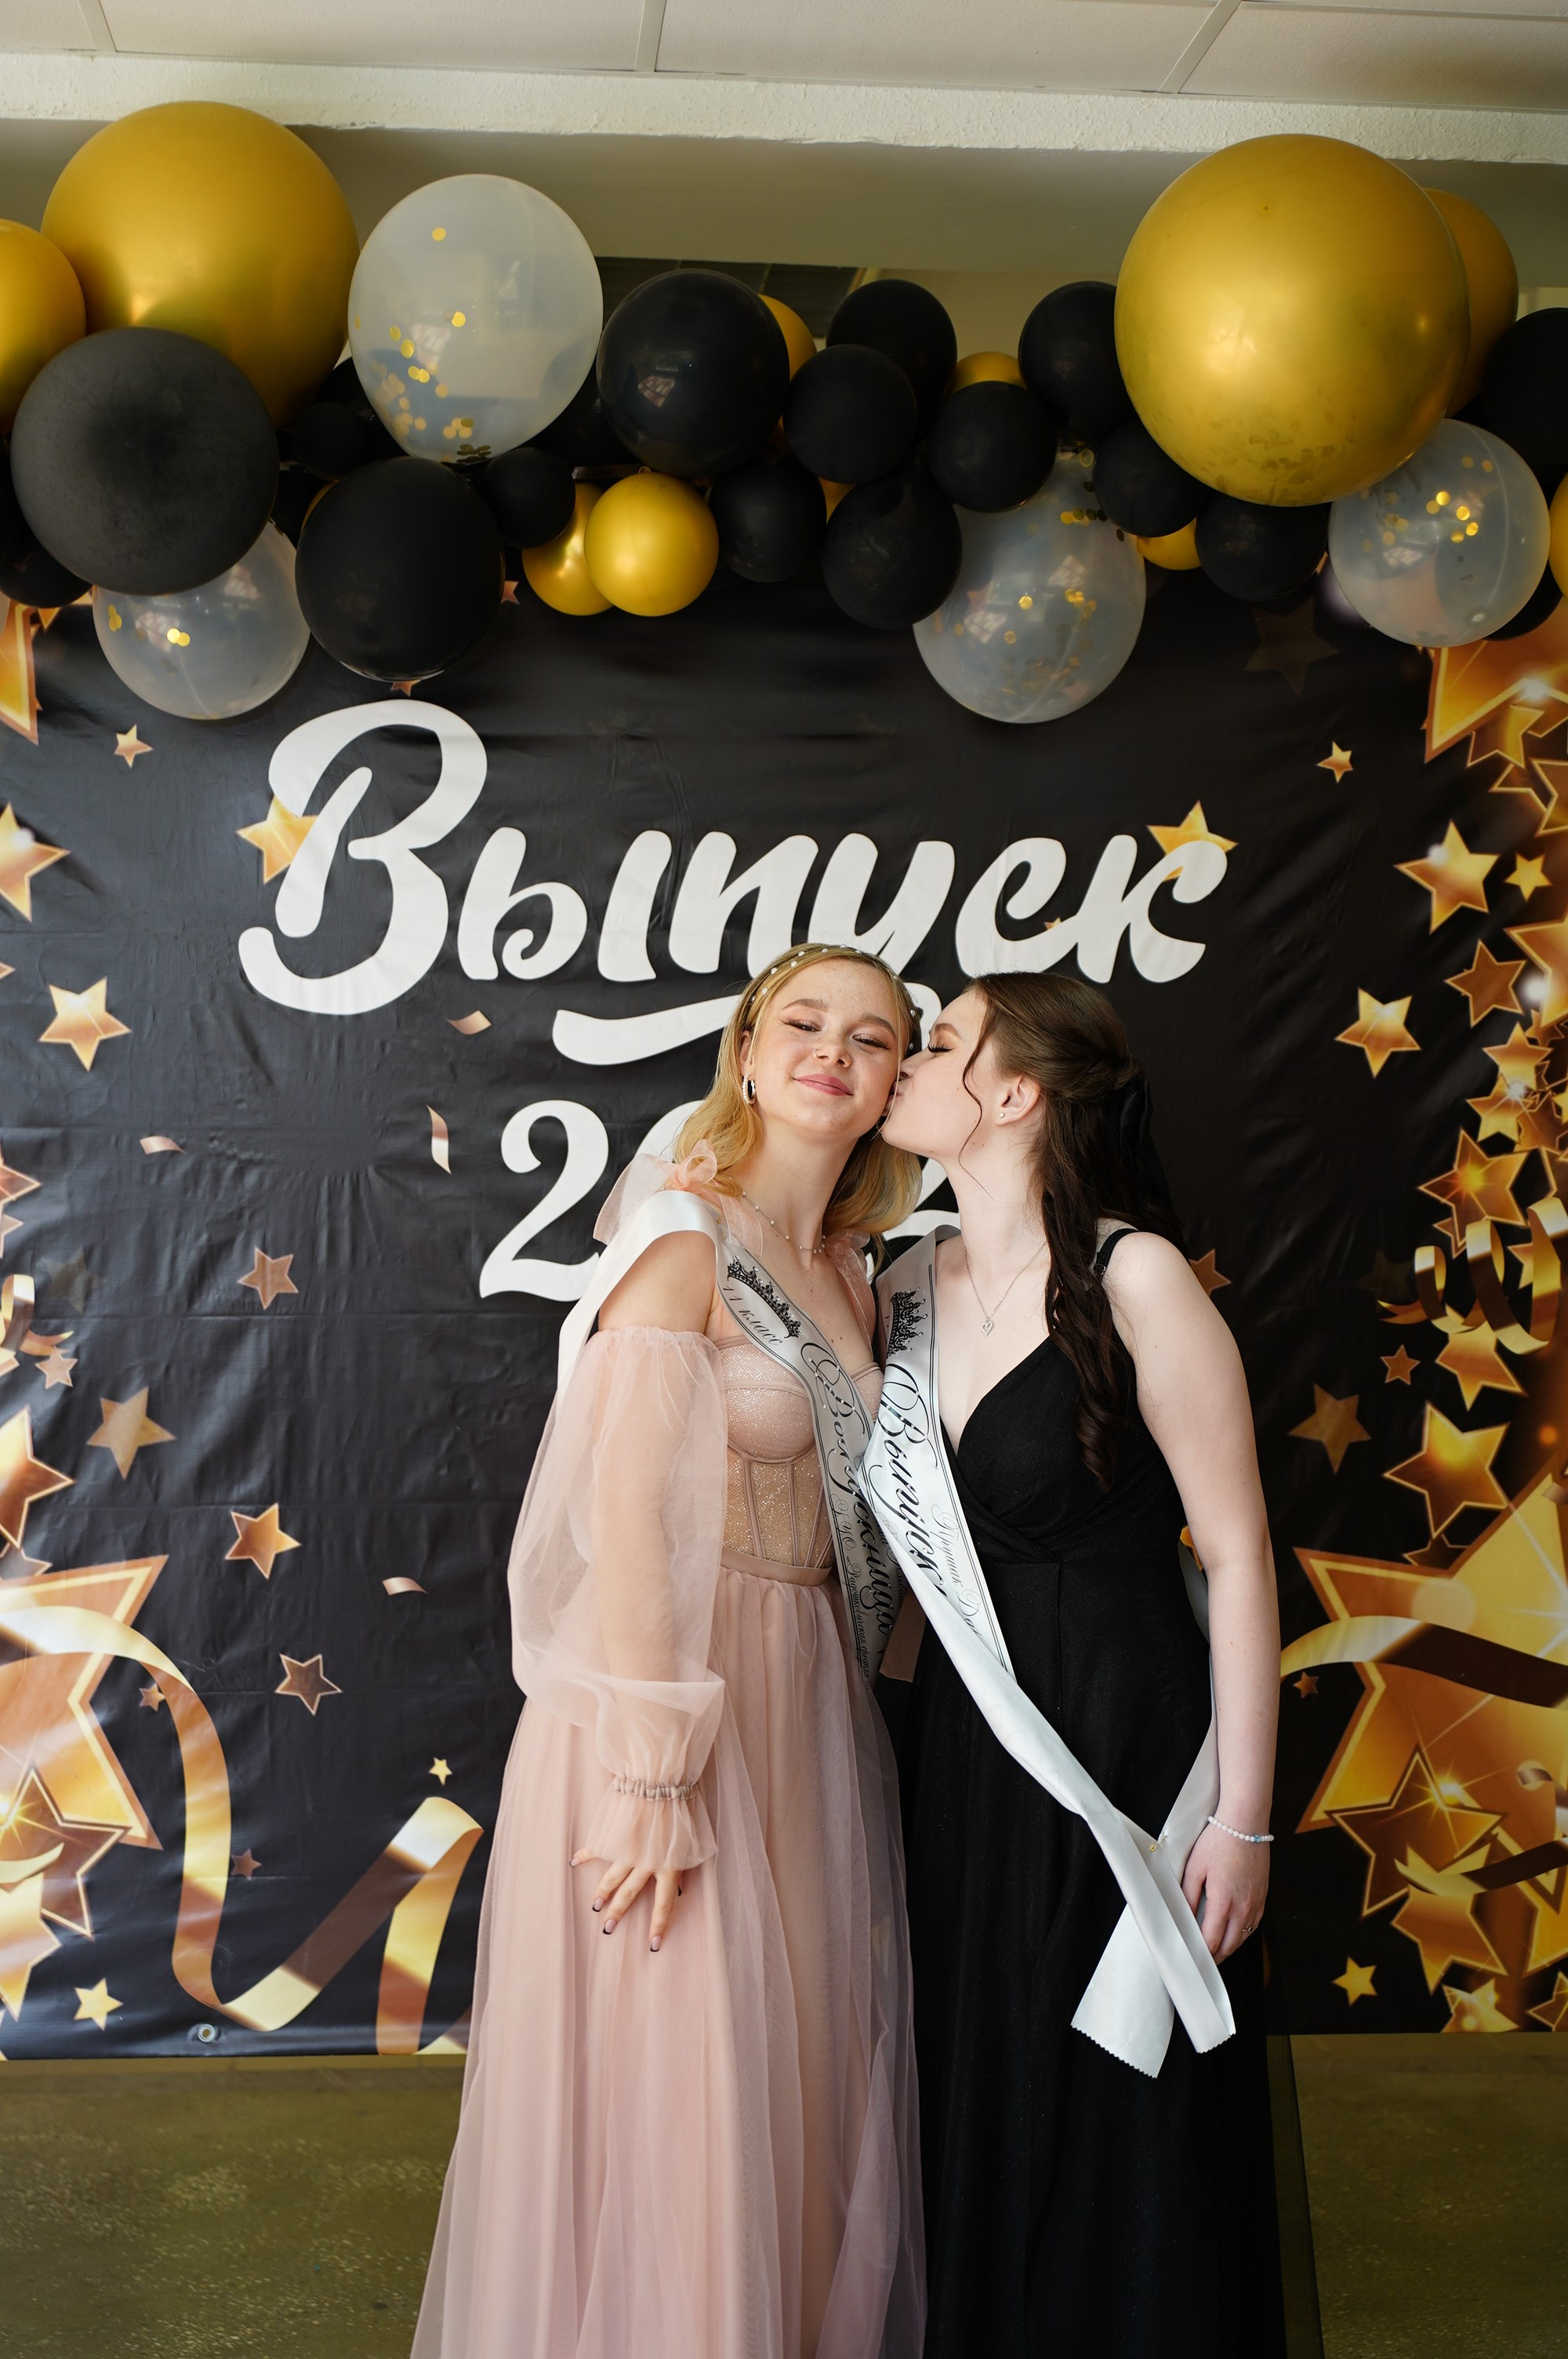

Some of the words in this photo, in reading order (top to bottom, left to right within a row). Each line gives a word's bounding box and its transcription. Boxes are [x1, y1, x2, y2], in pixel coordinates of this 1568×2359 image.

[238, 700, 1229, 1065] Выпуск
[723, 1286, 743, 1301] 11
[739, 1309, 783, 1345] класс
[869, 1363, 948, 1598] Выпуск
[931, 1504, 964, 1588] Прушак
